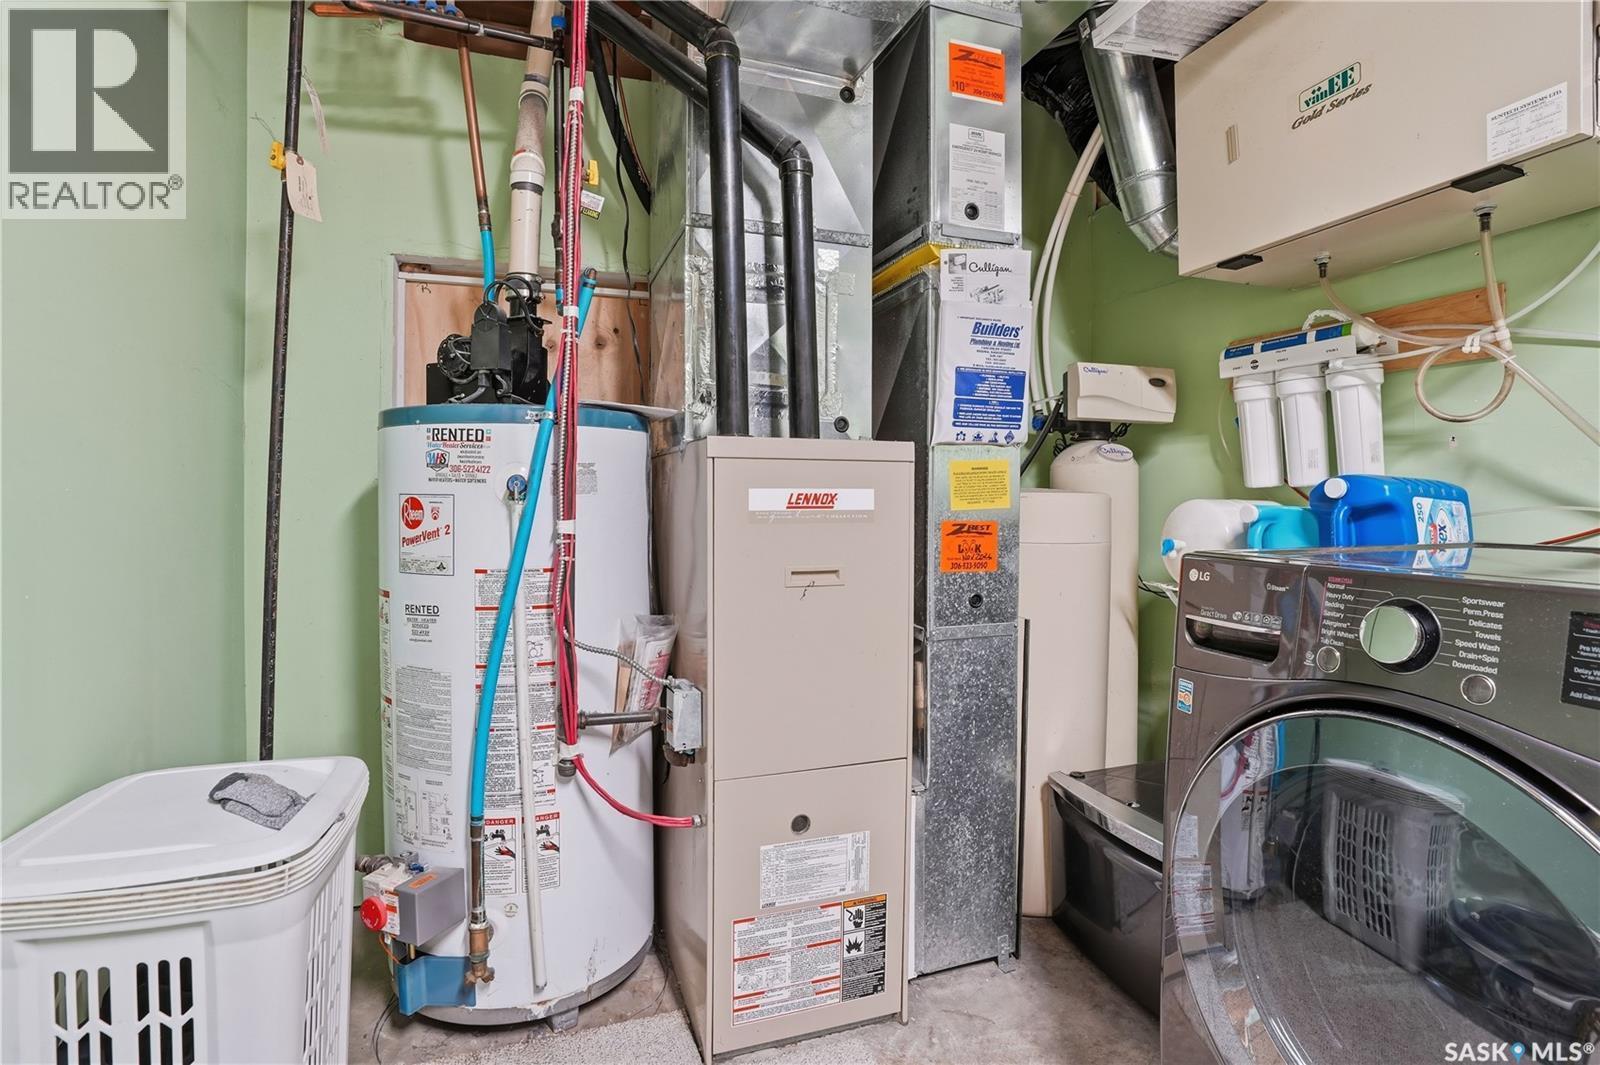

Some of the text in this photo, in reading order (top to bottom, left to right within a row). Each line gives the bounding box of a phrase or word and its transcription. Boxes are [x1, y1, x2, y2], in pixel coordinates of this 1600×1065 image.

[1291, 83, 1373, 130] Gold Series
[968, 261, 1012, 277] Culligan
[972, 321, 1024, 338] Builders'
[432, 428, 485, 442] RENTED
[787, 492, 838, 505] LENNOX
[444, 524, 451, 536] 2
[1199, 571, 1211, 581] LG
[1327, 582, 1346, 590] Normal
[1325, 591, 1355, 601] Heavy Duty
[1461, 596, 1506, 608] Sportswear
[405, 604, 440, 615] RENTED
[1324, 600, 1345, 610] Bedding
[1468, 619, 1503, 630] Delicates
[1321, 628, 1336, 637] Bright
[1474, 630, 1502, 641] Towels
[1454, 638, 1501, 652] Speed Wash
[1458, 650, 1500, 664] Drain+Spin
[1451, 660, 1499, 675] Downloaded
